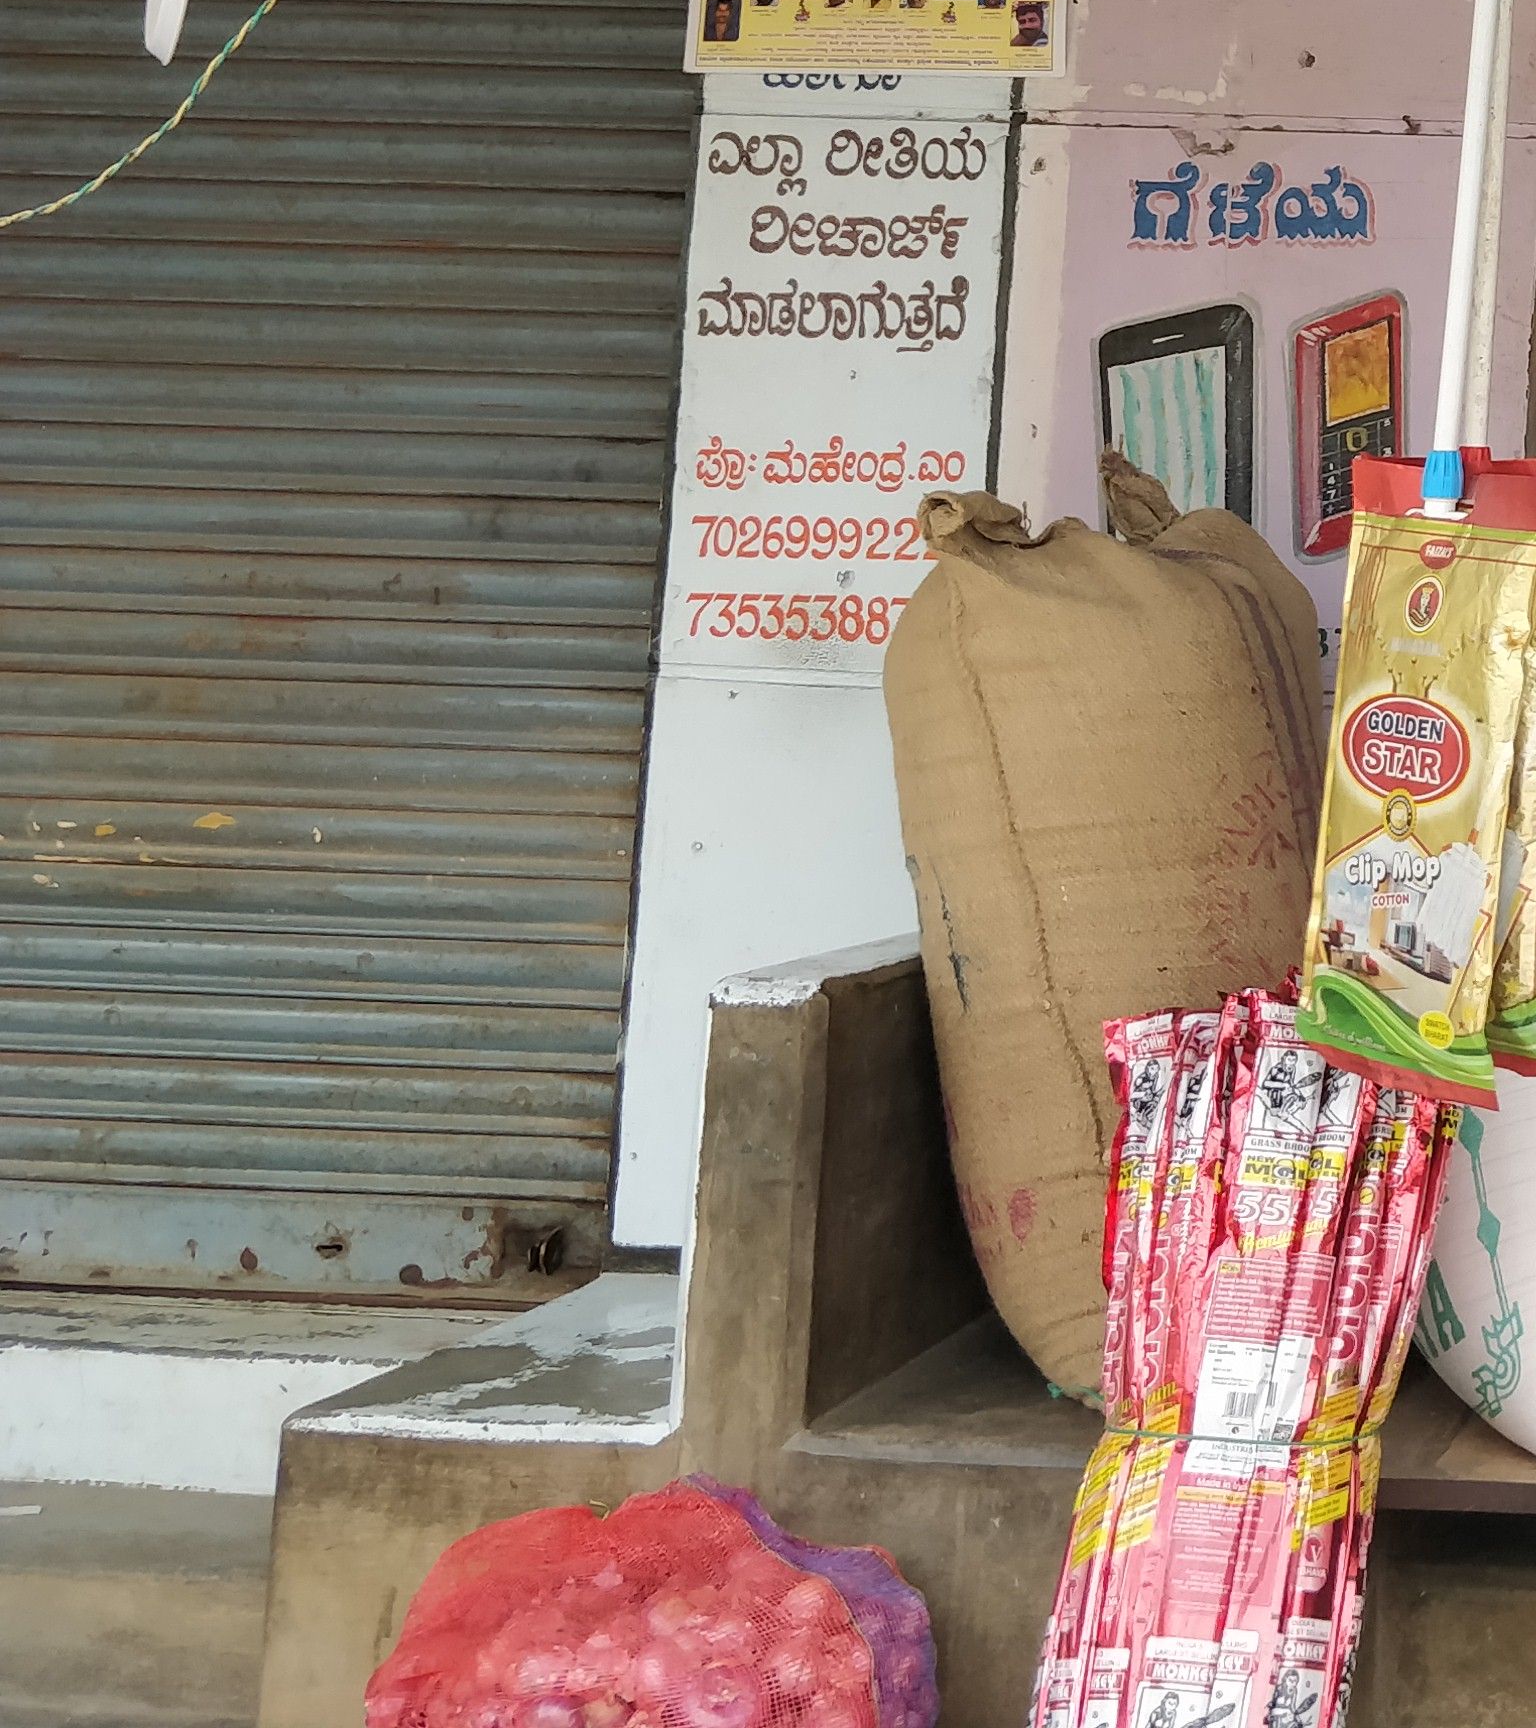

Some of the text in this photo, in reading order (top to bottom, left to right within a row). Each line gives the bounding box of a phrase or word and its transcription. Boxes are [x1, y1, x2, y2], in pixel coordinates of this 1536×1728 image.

[708, 125, 988, 196] ಎಲ್ಲಾ ರೀತಿಯ
[1128, 160, 1374, 250] ಗೆಳೆಯ
[749, 203, 970, 260] ರೀಚಾರ್ಜ್
[698, 275, 969, 353] ಮಾಡಲಾಗುತ್ತದೆ
[692, 515, 938, 561] 702699922
[686, 593, 908, 644] 73535388
[1367, 709, 1445, 742] GOLDEN
[1361, 739, 1443, 786] STAR
[1344, 851, 1442, 891] Clip Mop
[1371, 892, 1410, 909] COTTON
